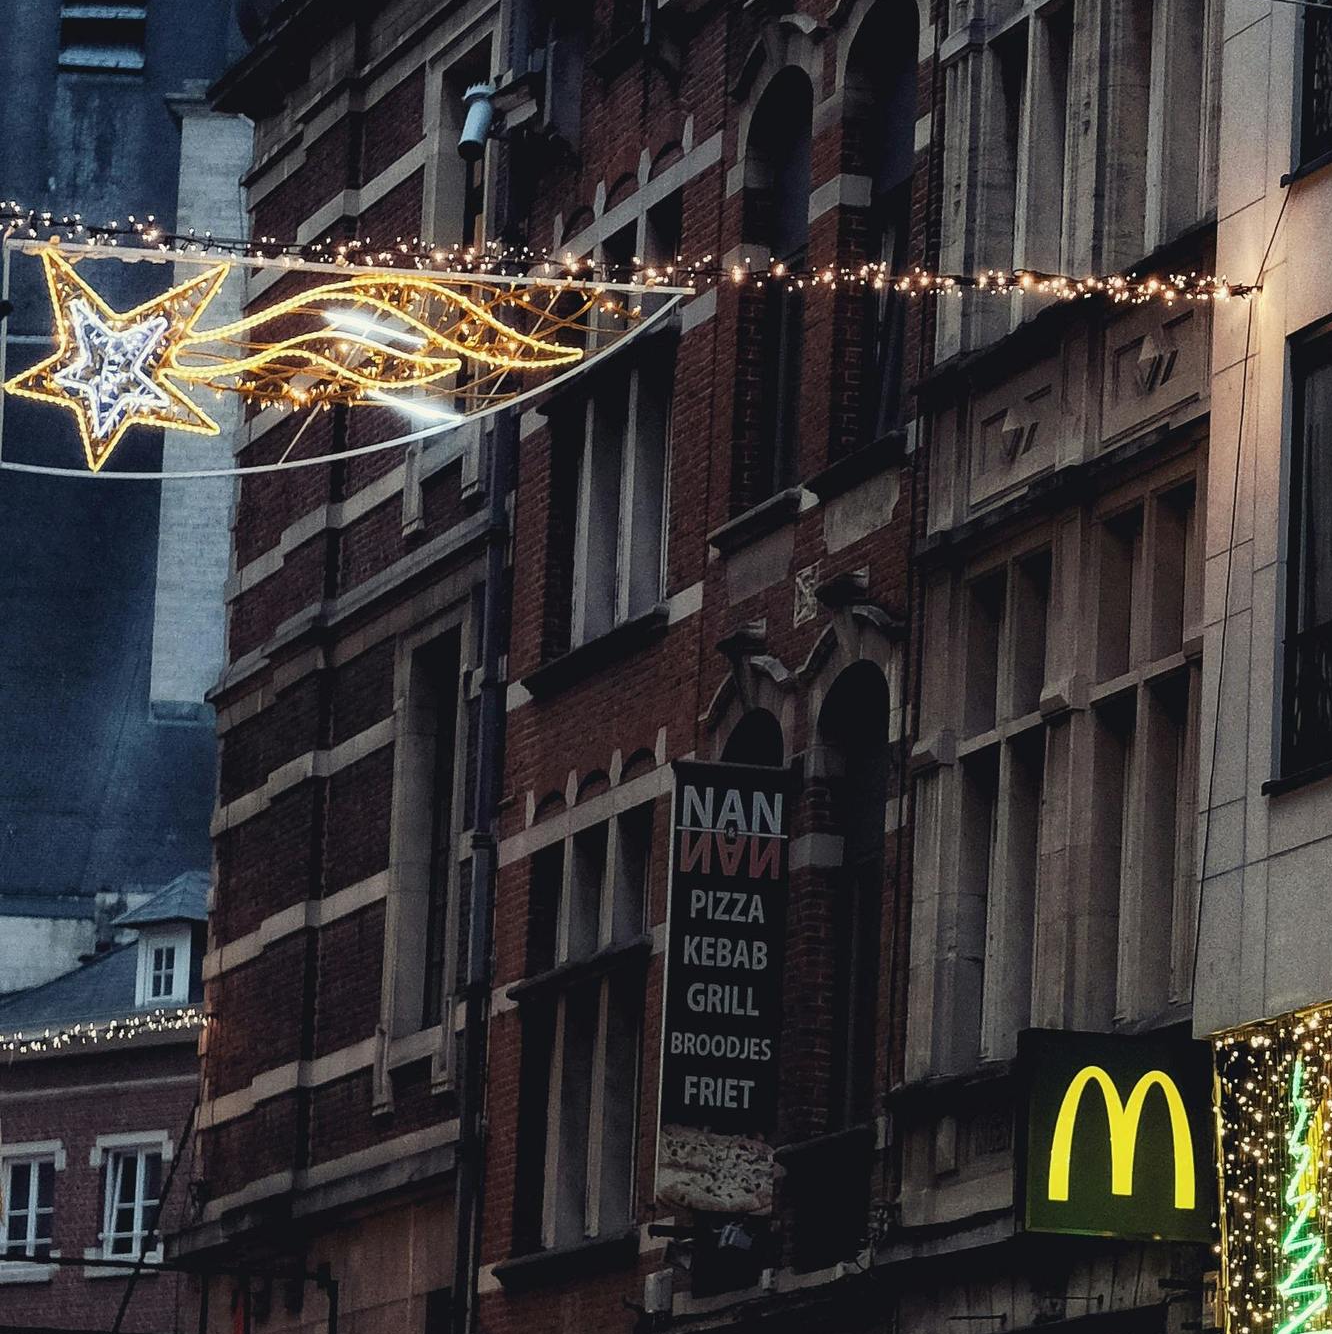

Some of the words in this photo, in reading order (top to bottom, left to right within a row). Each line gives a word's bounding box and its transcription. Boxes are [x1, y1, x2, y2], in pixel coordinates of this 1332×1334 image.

[681, 784, 784, 834] NAN
[689, 889, 765, 924] PIZZA
[683, 934, 768, 971] KEBAB
[686, 982, 760, 1017] GRILL
[670, 1031, 772, 1061] BROODJES
[683, 1075, 755, 1109] FRIET
